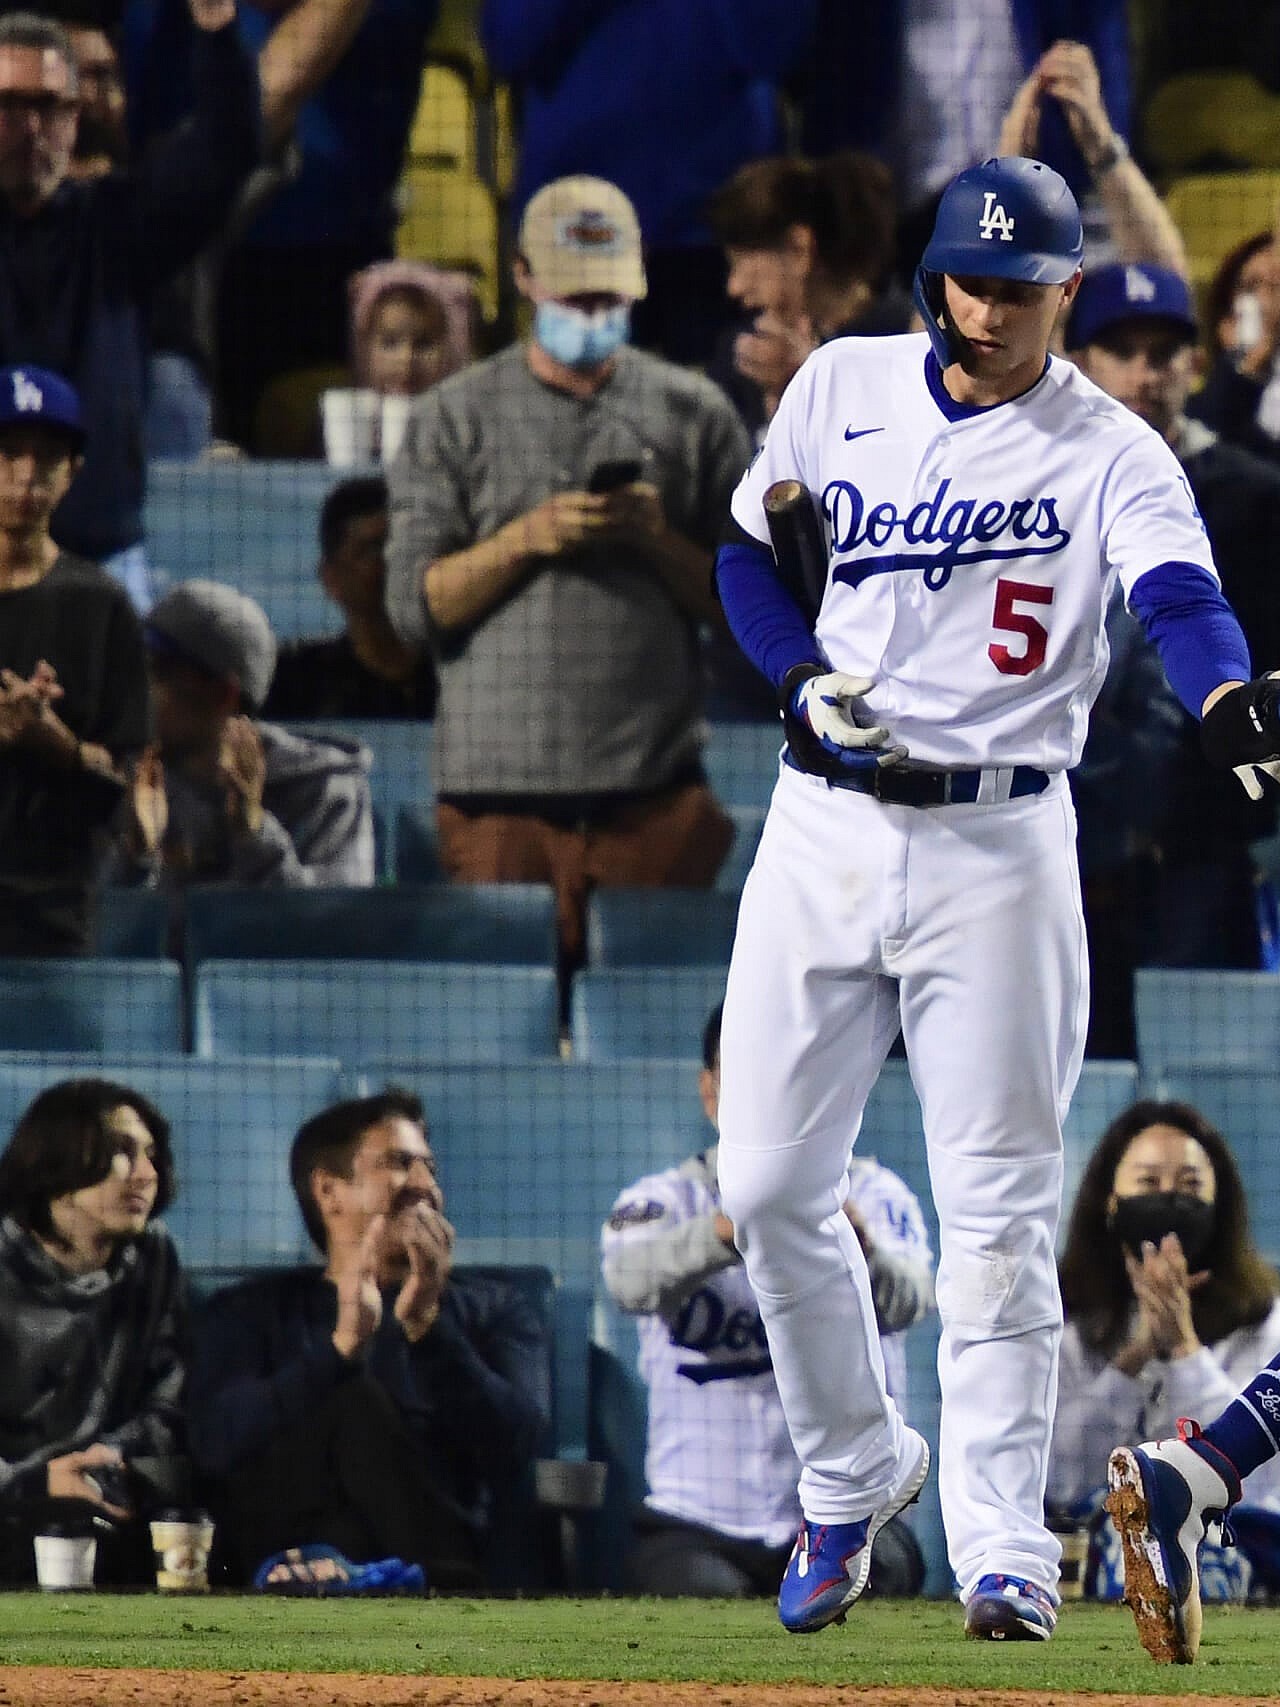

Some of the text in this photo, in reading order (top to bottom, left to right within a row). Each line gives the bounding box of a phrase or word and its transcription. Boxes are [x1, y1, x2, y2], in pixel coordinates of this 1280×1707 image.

[979, 192, 1014, 241] LA
[821, 477, 1071, 591] Dodgers
[988, 577, 1054, 676] 5
[1255, 1388, 1280, 1413] Los
